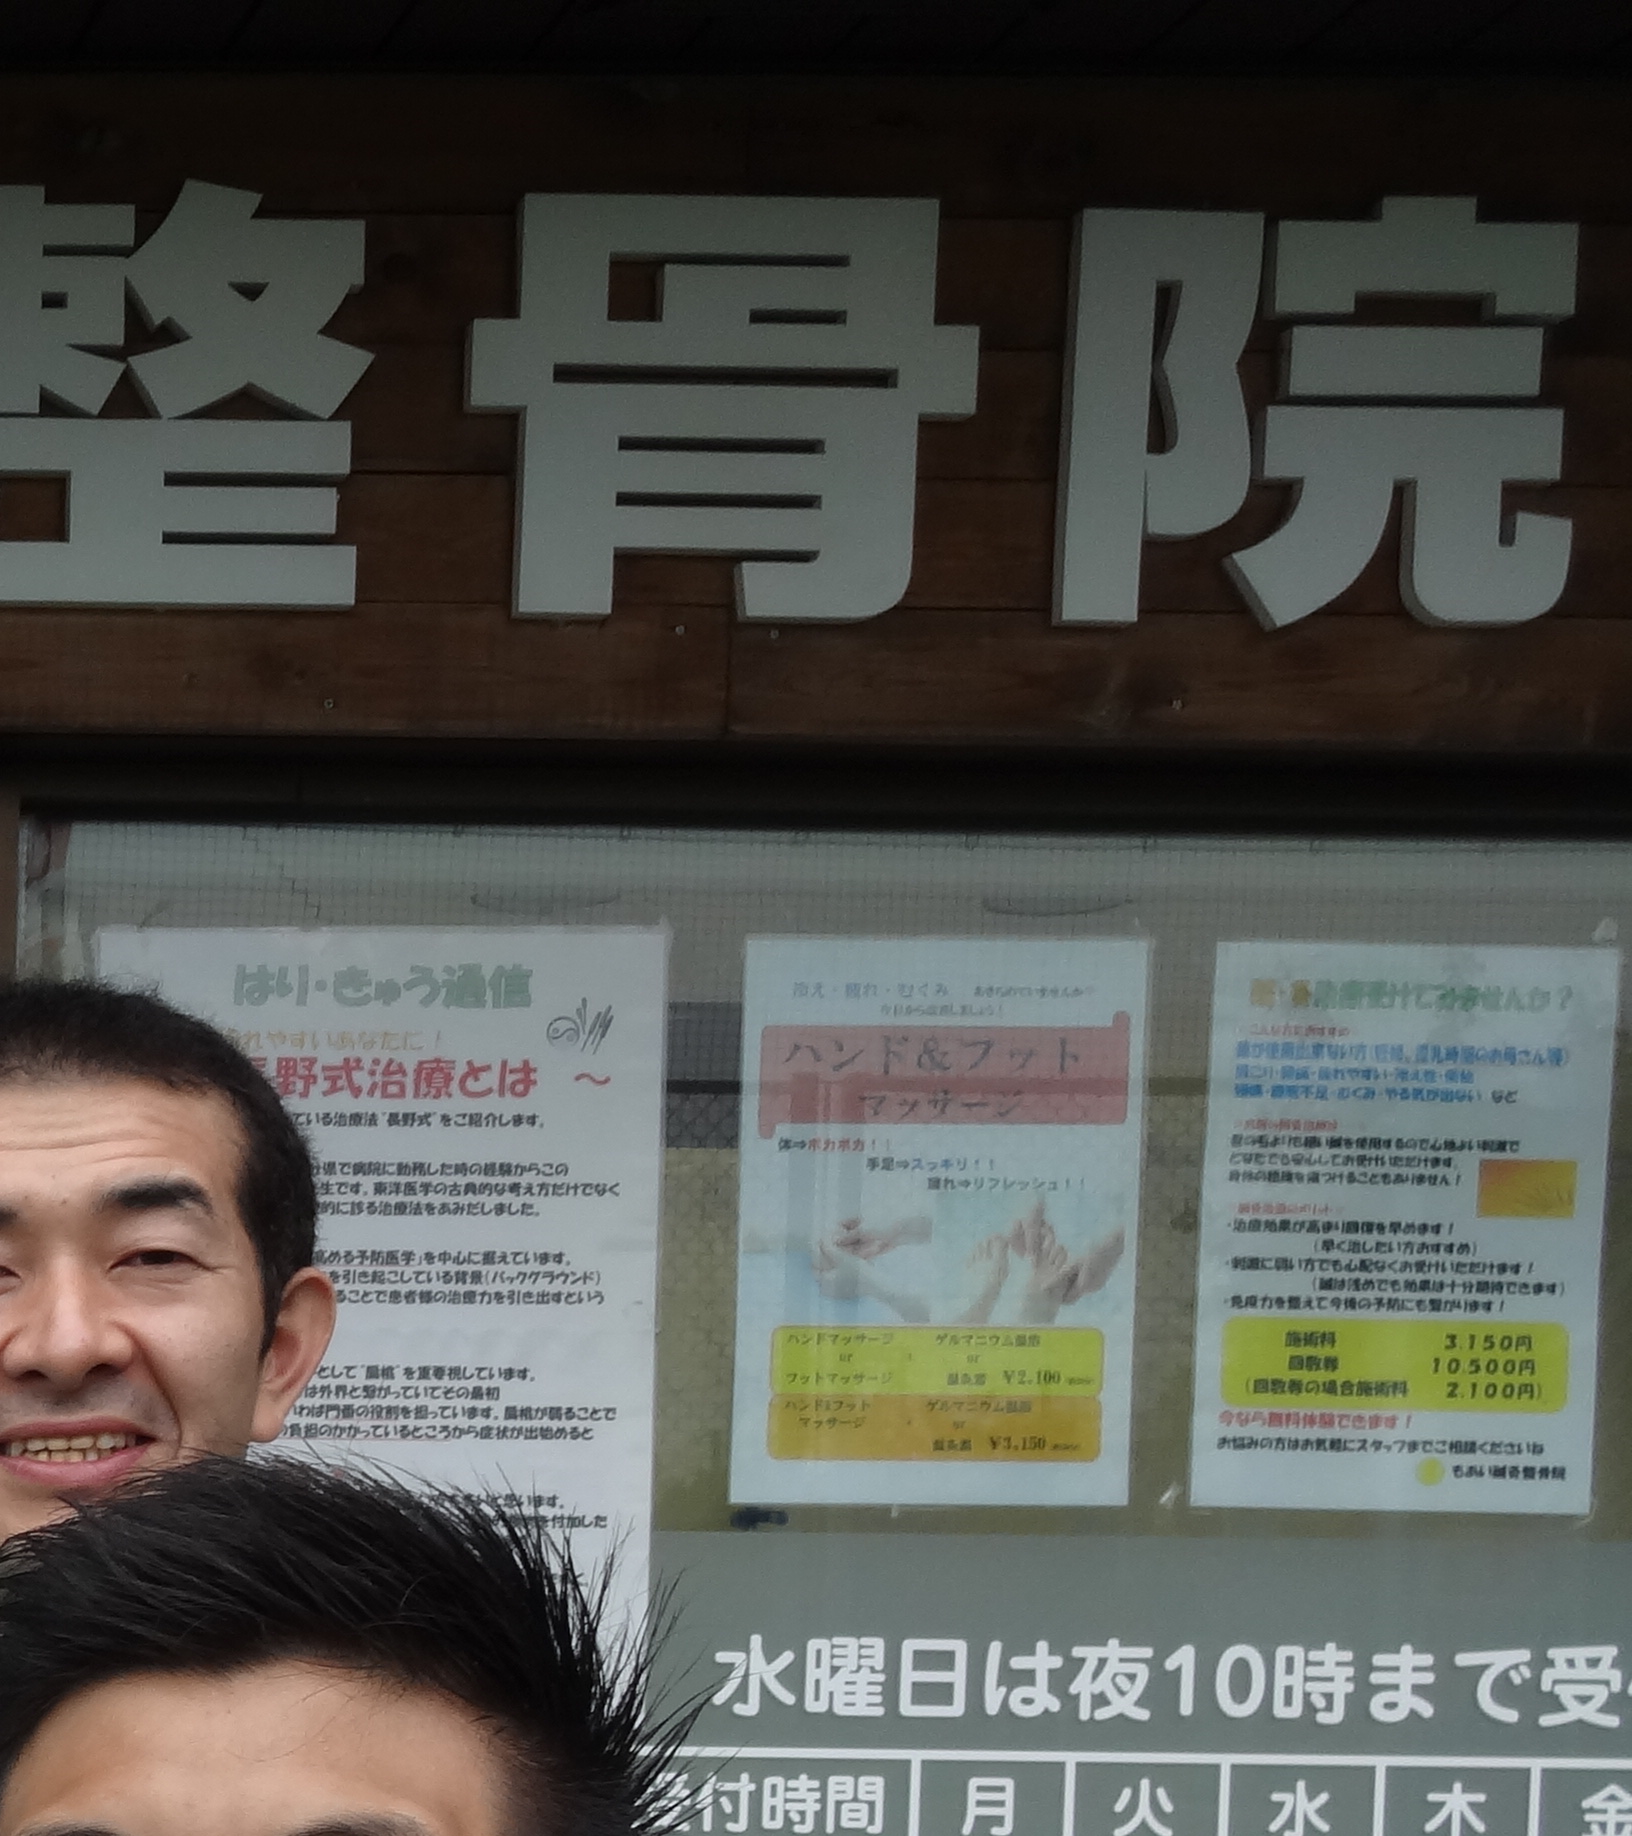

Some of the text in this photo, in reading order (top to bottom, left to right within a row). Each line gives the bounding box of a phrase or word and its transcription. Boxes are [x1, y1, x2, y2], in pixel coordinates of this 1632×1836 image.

[233, 962, 535, 1008] はり・きゅう通信
[315, 1180, 622, 1198] 生です。東洋医学の古典的な考え方だけでなく
[712, 1634, 1632, 1730] 水曜日は夜10時まで受
